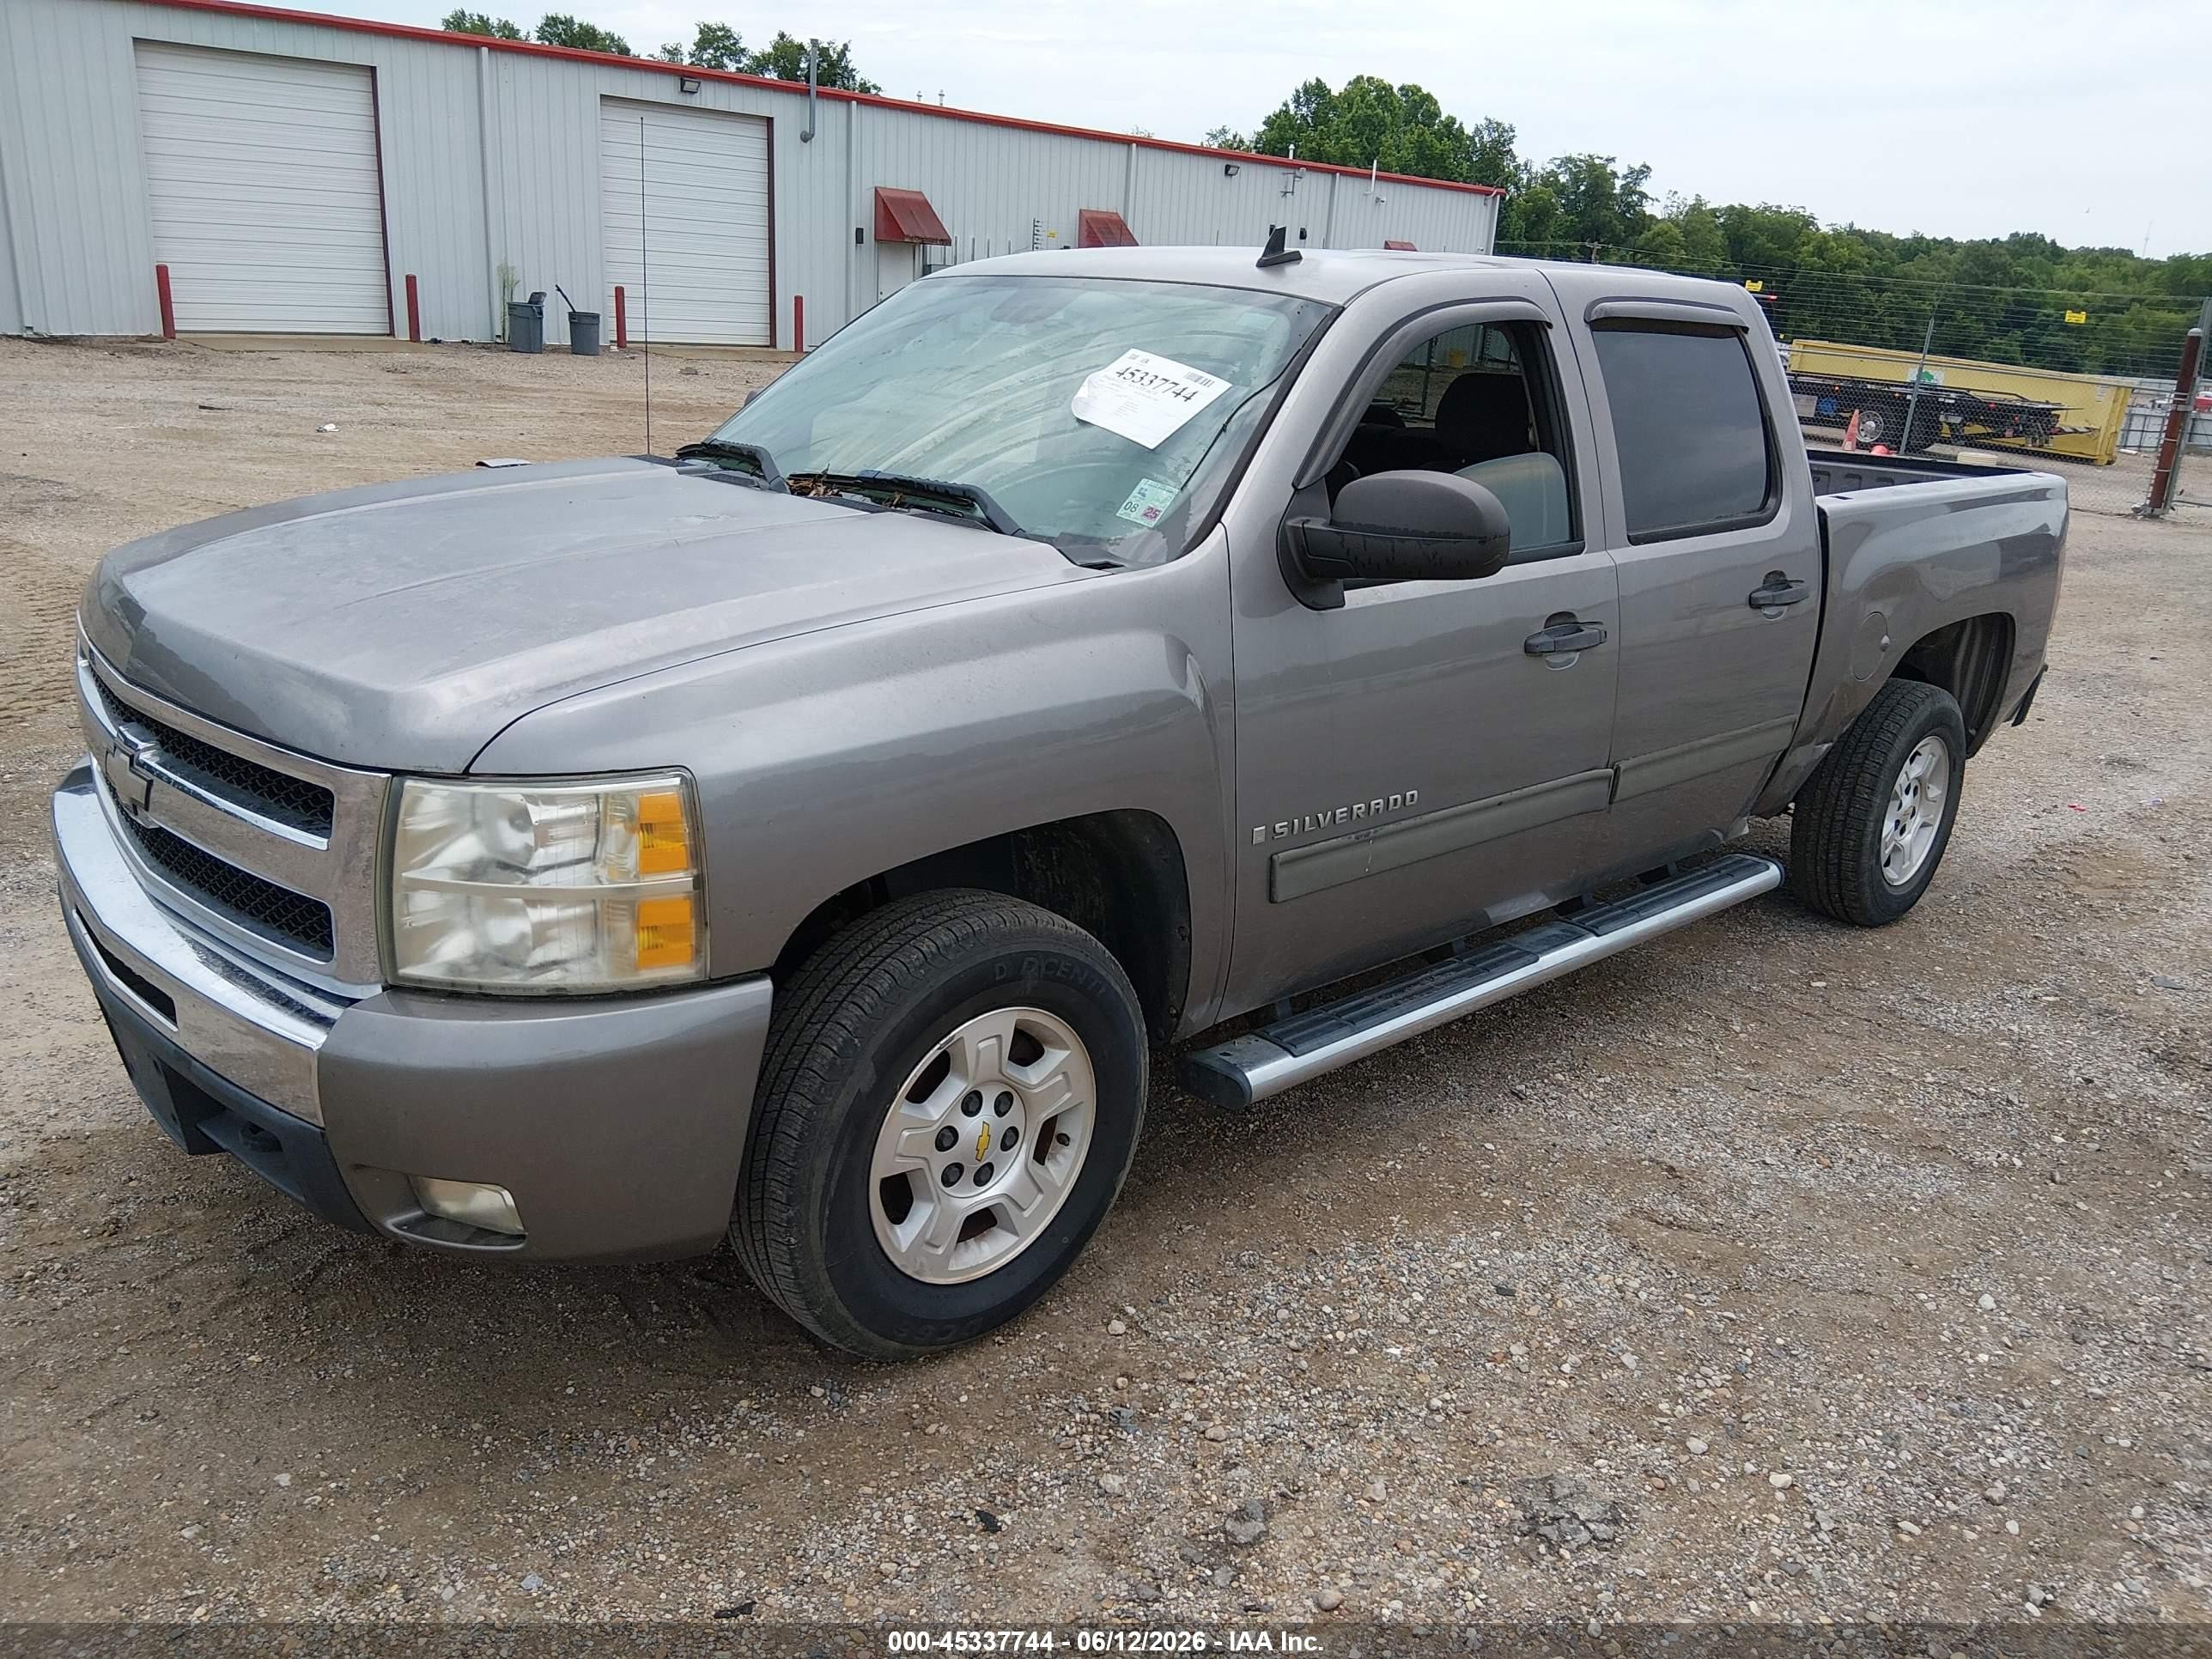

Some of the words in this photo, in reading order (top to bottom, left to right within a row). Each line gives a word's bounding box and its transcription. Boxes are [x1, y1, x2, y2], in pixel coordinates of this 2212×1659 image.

[1115, 367, 1199, 402] 45337744
[1123, 501, 1139, 513] 08
[1143, 505, 1162, 520] 25
[1272, 789, 1419, 839] SILVERADO
